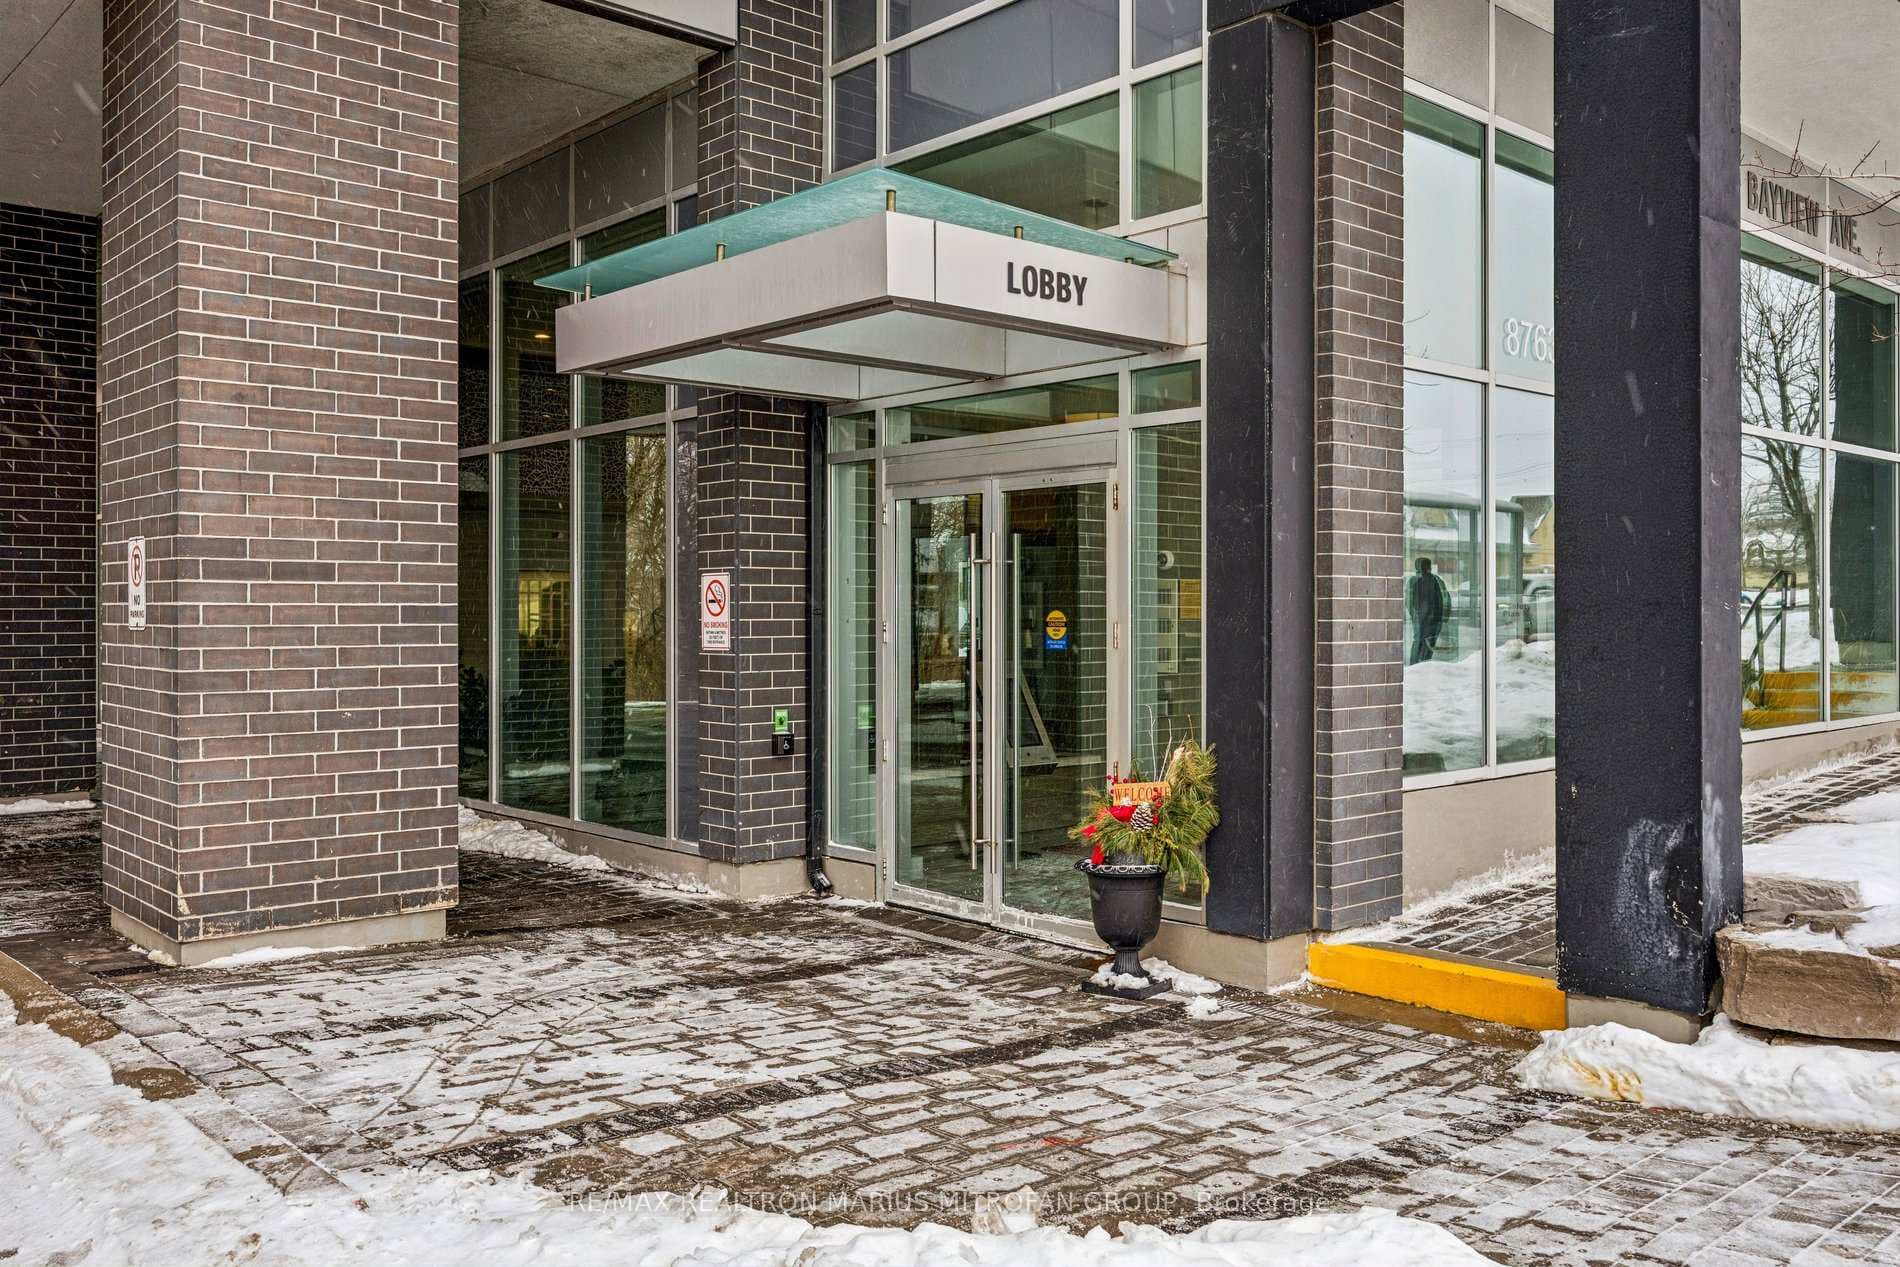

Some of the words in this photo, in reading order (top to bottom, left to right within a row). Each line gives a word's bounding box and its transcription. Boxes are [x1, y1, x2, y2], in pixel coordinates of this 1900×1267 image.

[1747, 171, 1819, 237] BAYVIEW
[1007, 261, 1088, 306] LOBBY
[133, 594, 141, 606] NO
